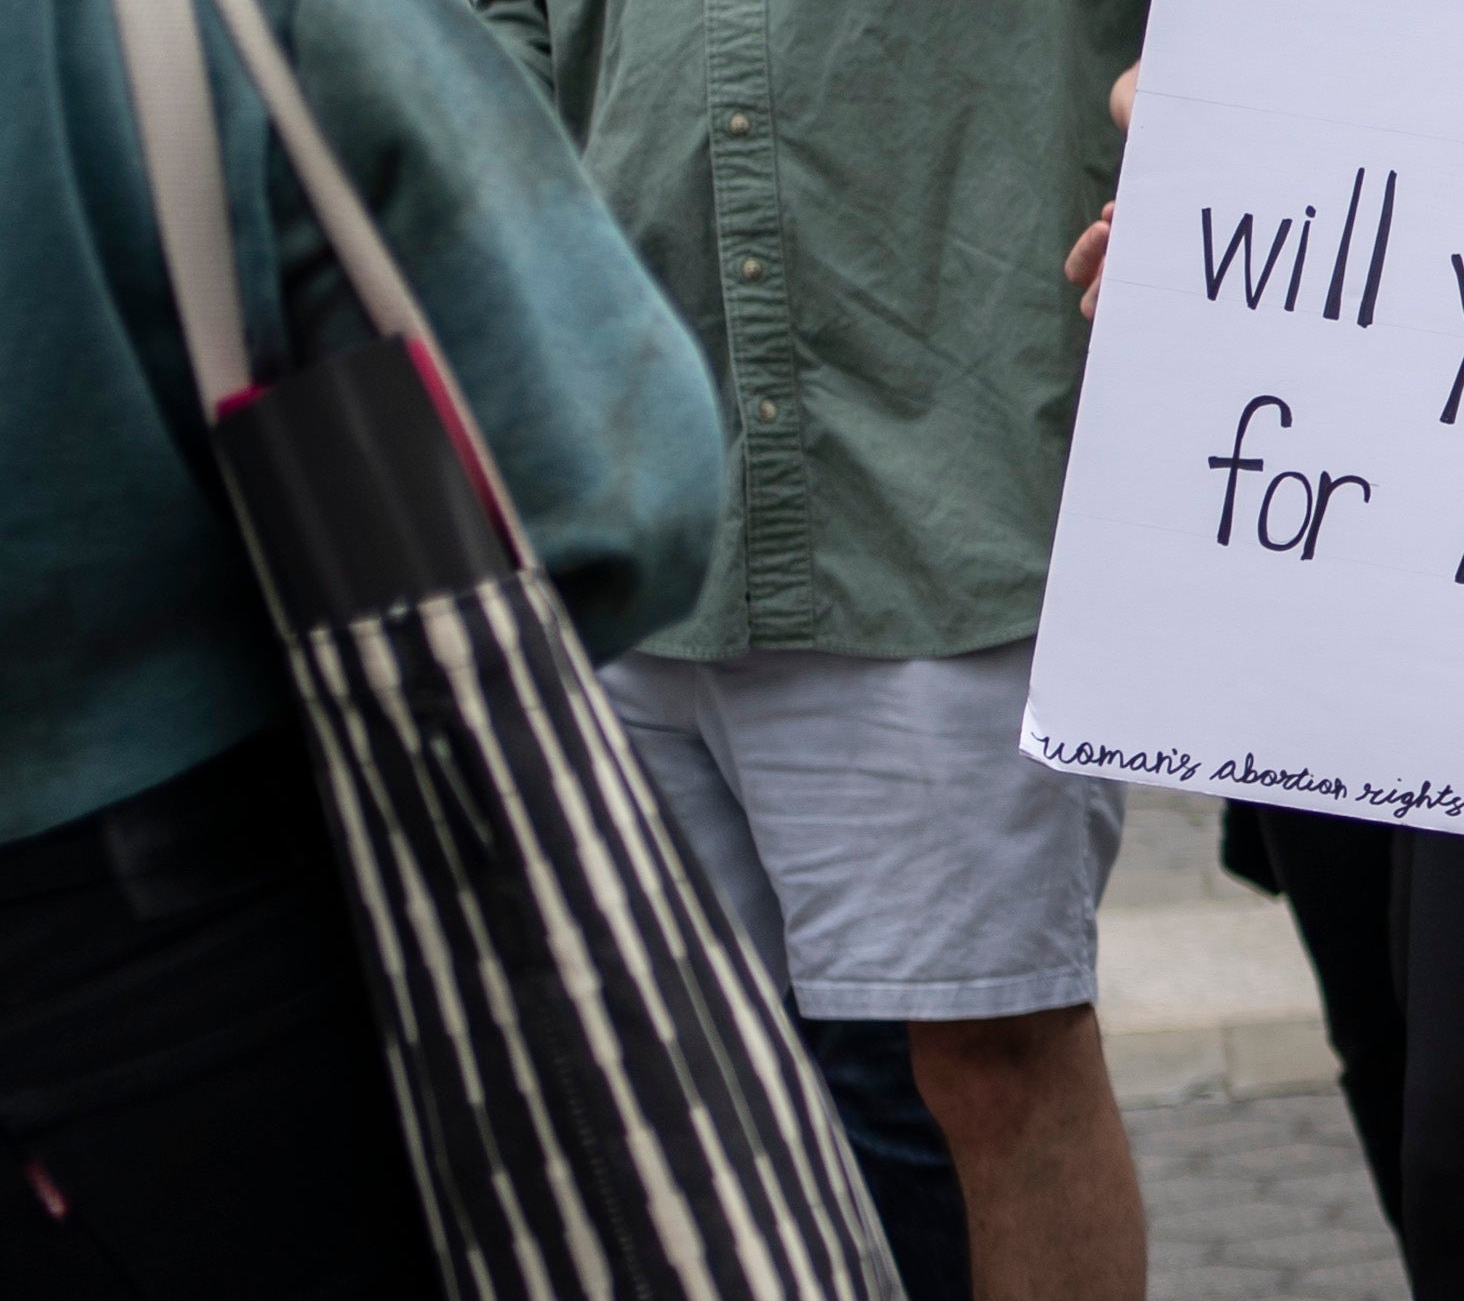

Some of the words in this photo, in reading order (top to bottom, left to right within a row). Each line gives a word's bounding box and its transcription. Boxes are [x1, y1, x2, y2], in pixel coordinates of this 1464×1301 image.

[1201, 167, 1397, 330] will
[1208, 395, 1371, 562] for
[1209, 752, 1349, 801] abortion
